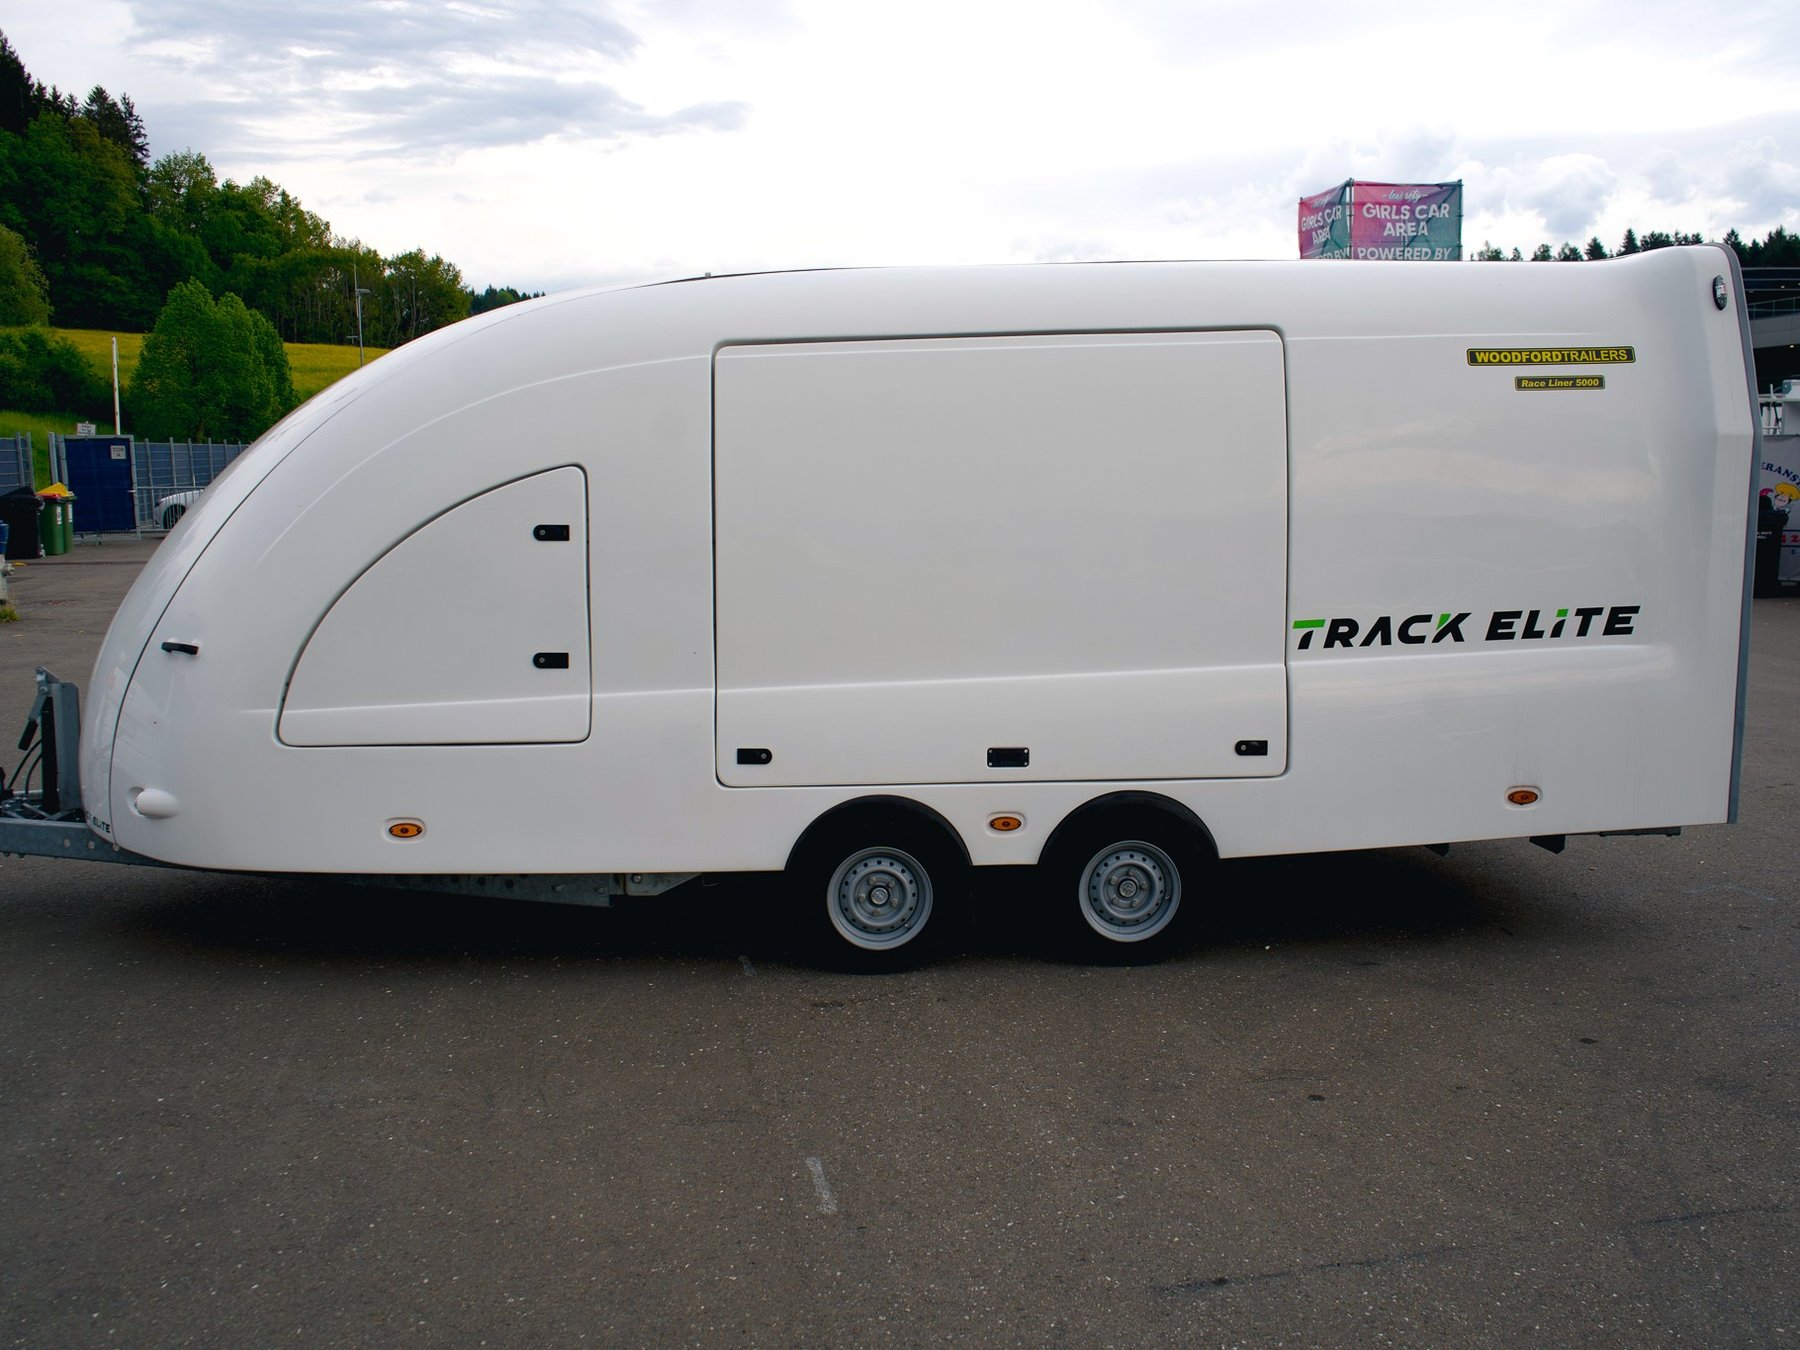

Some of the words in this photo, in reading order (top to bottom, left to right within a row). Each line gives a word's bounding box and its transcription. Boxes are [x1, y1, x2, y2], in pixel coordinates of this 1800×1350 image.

[1363, 202, 1411, 220] GIRLS
[1415, 203, 1450, 219] CAR
[1301, 212, 1324, 232] GIRLS
[1383, 221, 1428, 237] AREA
[1357, 247, 1431, 260] POWERED
[1434, 247, 1452, 260] BY
[1475, 350, 1628, 363] WOODFORDTRAILERS
[1521, 379, 1546, 388] Race
[1548, 379, 1574, 387] Liner
[1575, 378, 1599, 387] 5000
[1292, 612, 1472, 650] TRACK
